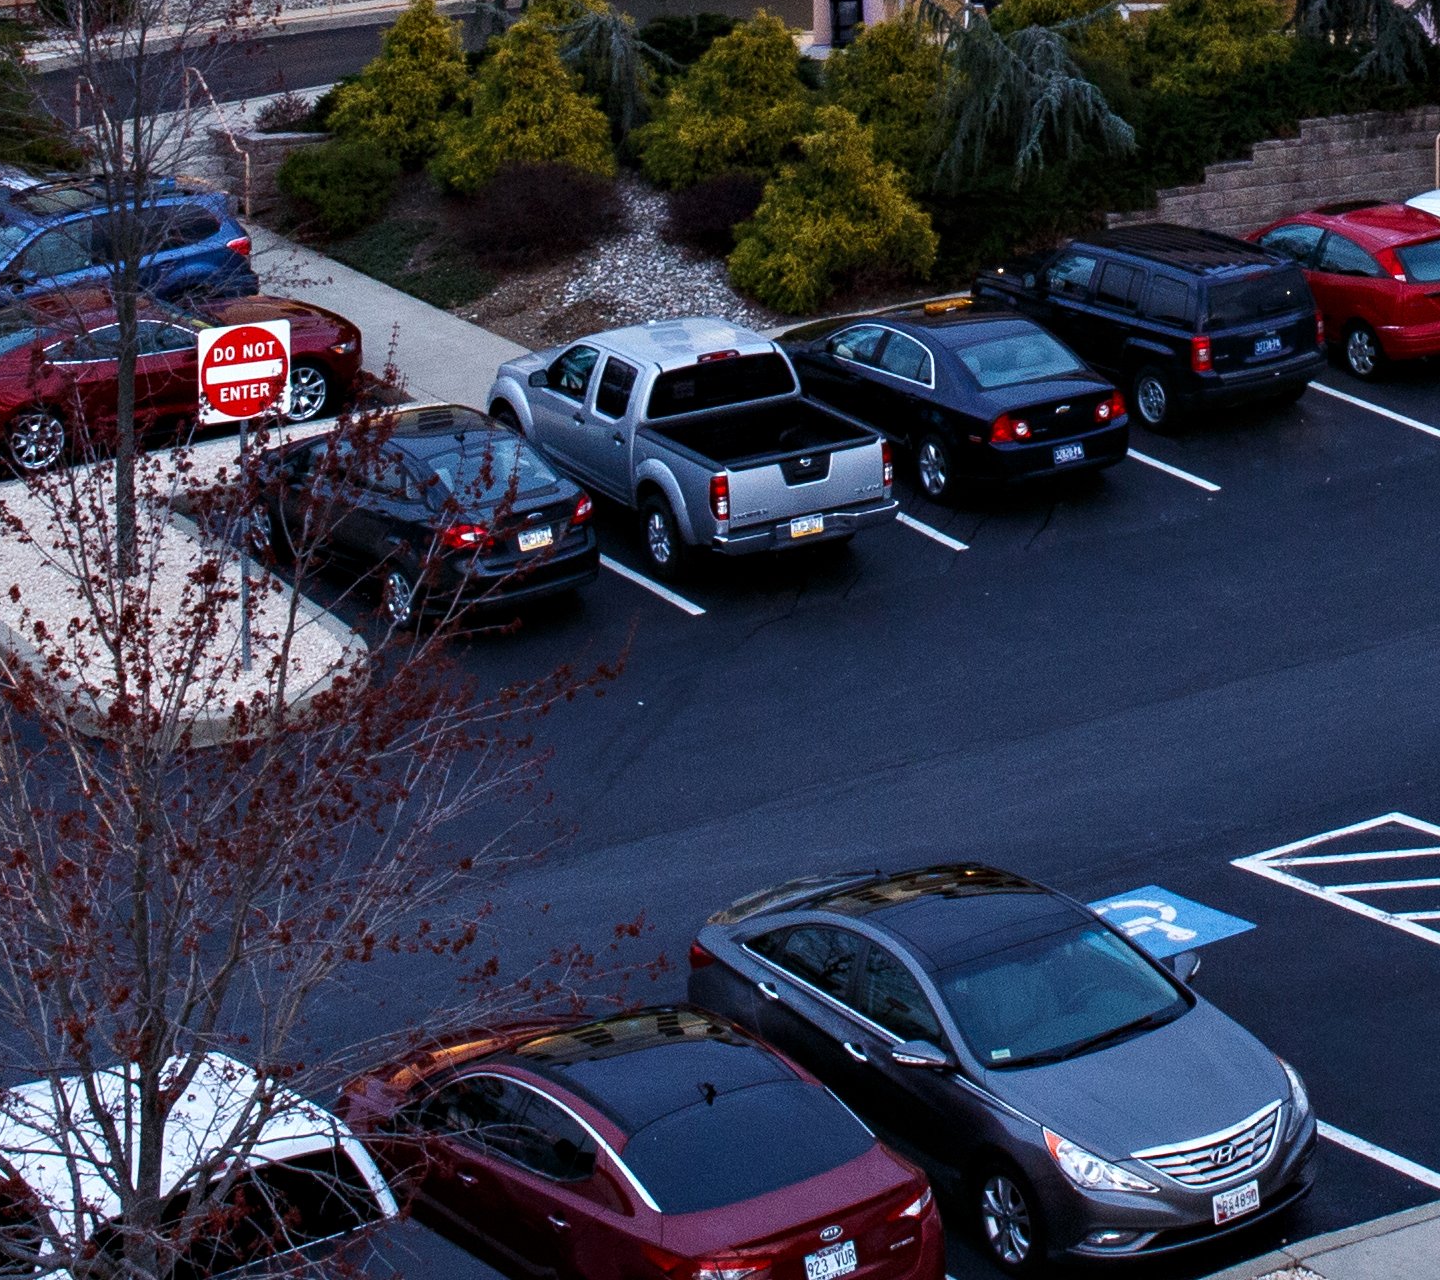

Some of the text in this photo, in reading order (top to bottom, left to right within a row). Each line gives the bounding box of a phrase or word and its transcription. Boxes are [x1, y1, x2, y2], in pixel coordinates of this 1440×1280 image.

[213, 341, 275, 363] DO NOT
[220, 382, 270, 403] ENTER
[807, 1258, 828, 1277] 923
[834, 1248, 856, 1268] VUR
